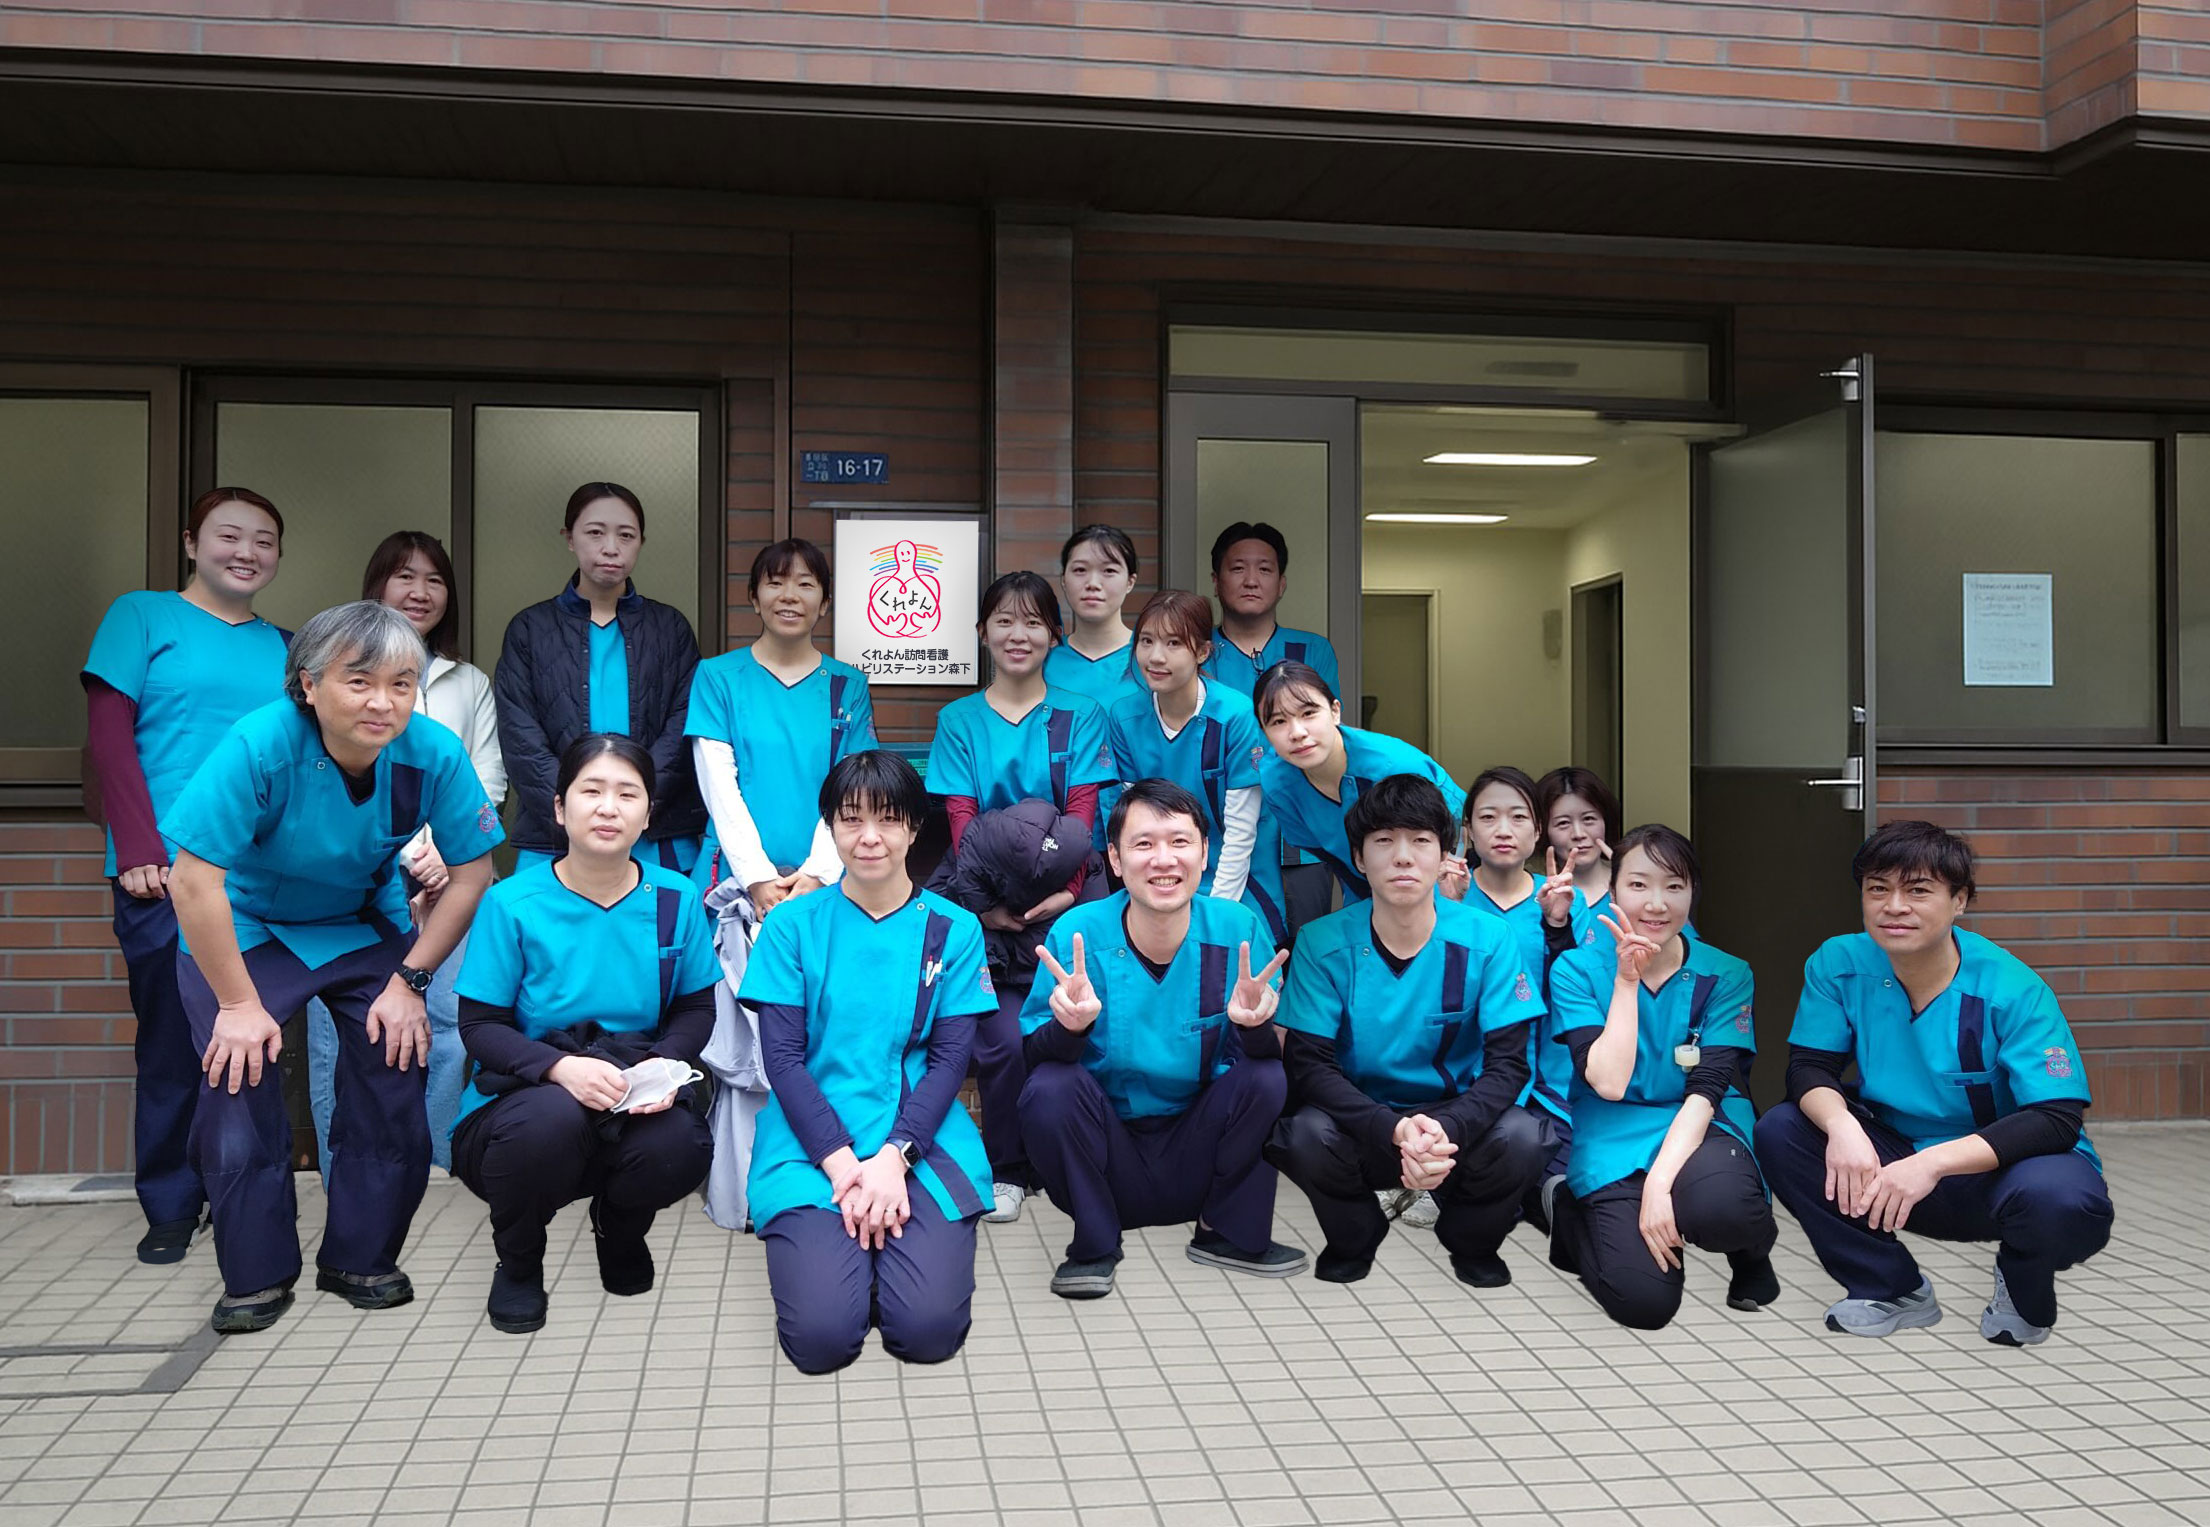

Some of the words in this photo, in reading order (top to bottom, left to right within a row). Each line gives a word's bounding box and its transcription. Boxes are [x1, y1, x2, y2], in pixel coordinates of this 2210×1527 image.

[837, 459, 883, 476] 16-17
[879, 590, 932, 611] くれよん
[861, 648, 949, 661] くれよん訪問看護
